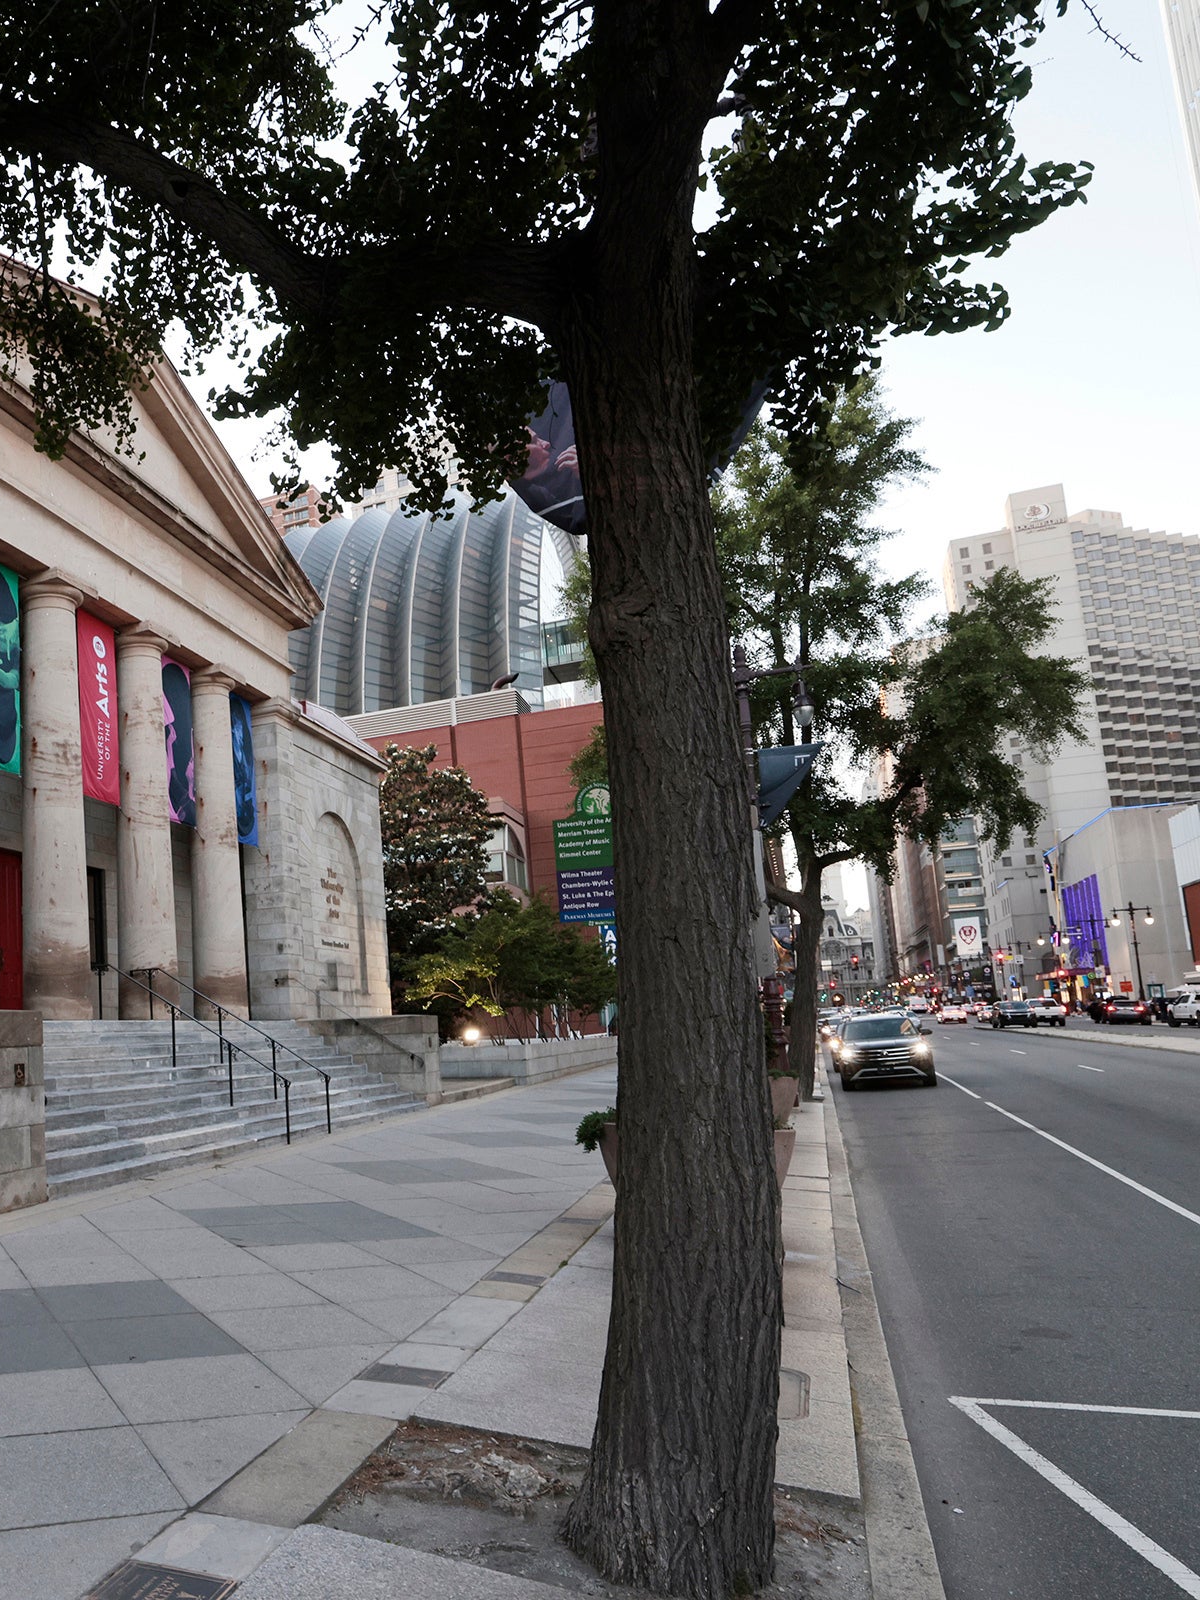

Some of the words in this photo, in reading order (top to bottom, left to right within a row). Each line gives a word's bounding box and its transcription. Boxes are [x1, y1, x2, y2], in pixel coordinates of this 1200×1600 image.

[96, 662, 110, 719] Arts
[104, 746, 111, 761] OF
[557, 820, 586, 828] University
[561, 880, 609, 889] Chambers-Wylie
